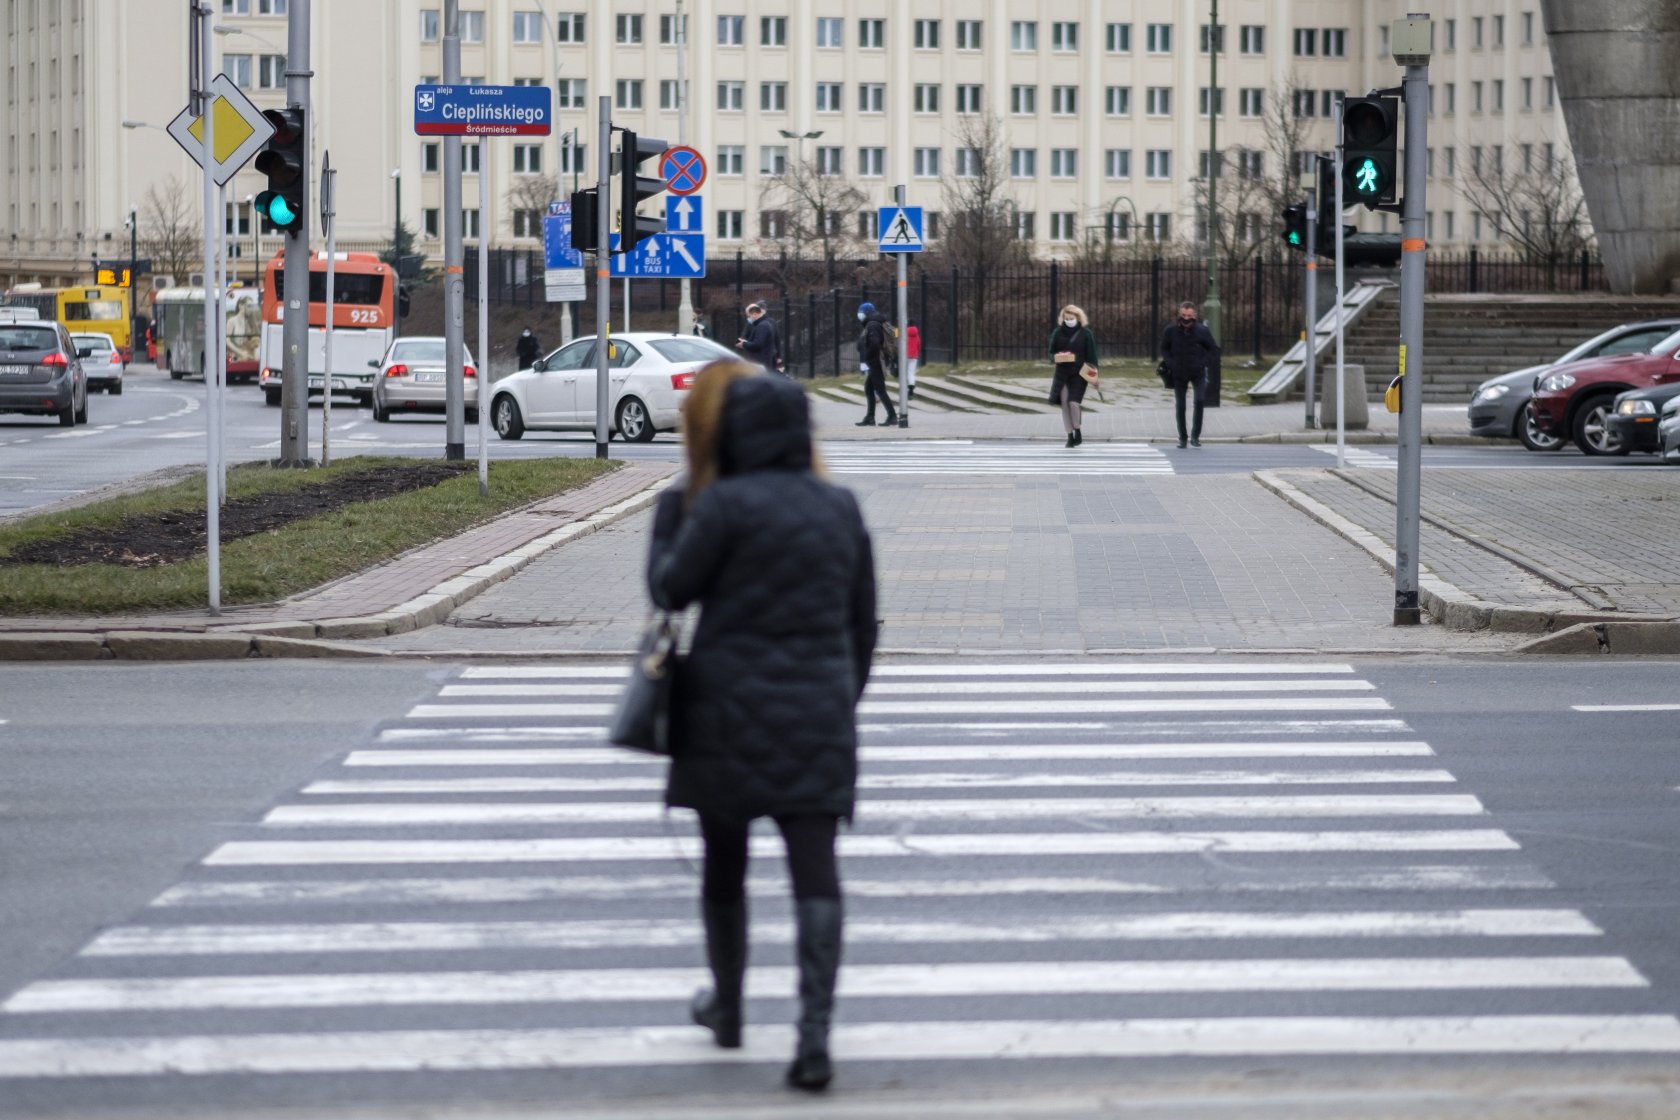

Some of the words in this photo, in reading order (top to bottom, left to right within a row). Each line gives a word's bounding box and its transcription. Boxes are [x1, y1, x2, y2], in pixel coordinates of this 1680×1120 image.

[437, 86, 453, 95] aleja
[469, 87, 503, 96] Łukasza
[442, 103, 544, 123] Cieplińskiego
[466, 123, 517, 134] Śródmieście
[644, 257, 661, 265] BUS
[643, 265, 662, 273] TAXI
[350, 309, 378, 323] 925
